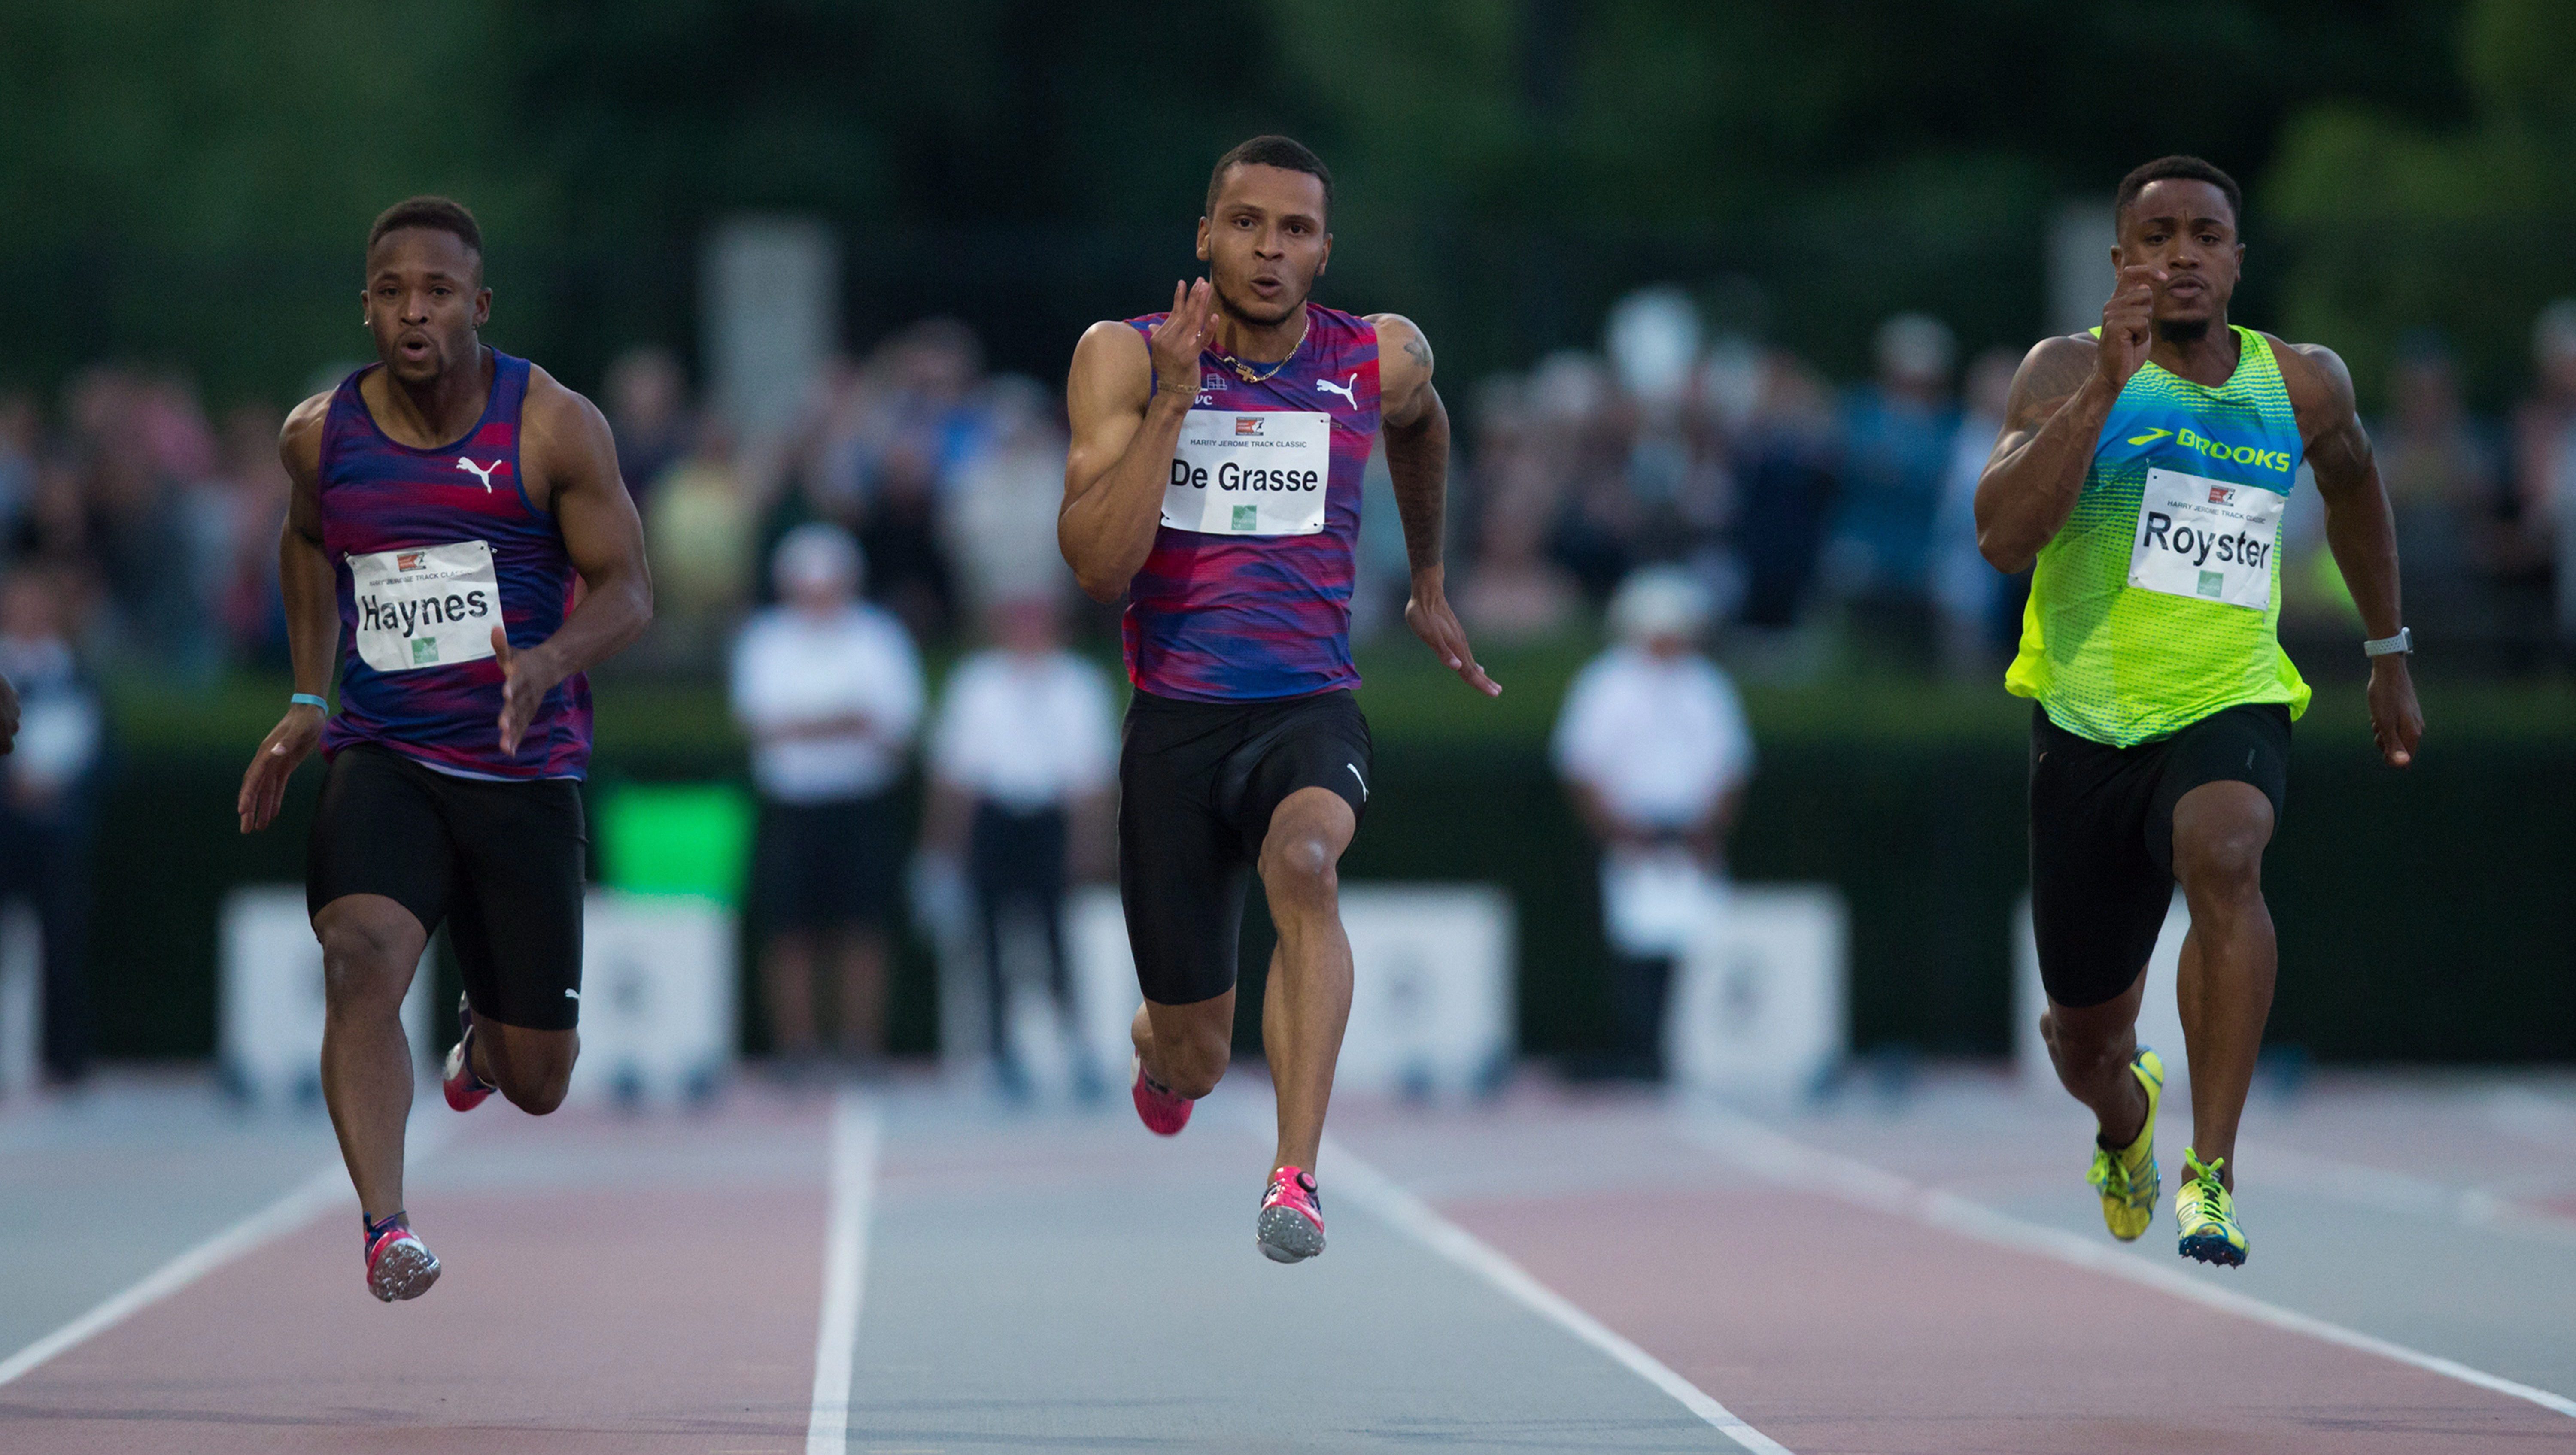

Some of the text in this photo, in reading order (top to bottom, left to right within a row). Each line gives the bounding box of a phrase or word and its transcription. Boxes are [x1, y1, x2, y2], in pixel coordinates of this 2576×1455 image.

[2176, 428, 2290, 472] BROOKS
[1171, 458, 1318, 491] De Grasse
[2167, 500, 2193, 510] HARRY
[2194, 506, 2219, 516] JEROME
[2221, 509, 2245, 520] TRACK
[2143, 511, 2270, 569] Royster
[361, 590, 488, 638] Haynes
